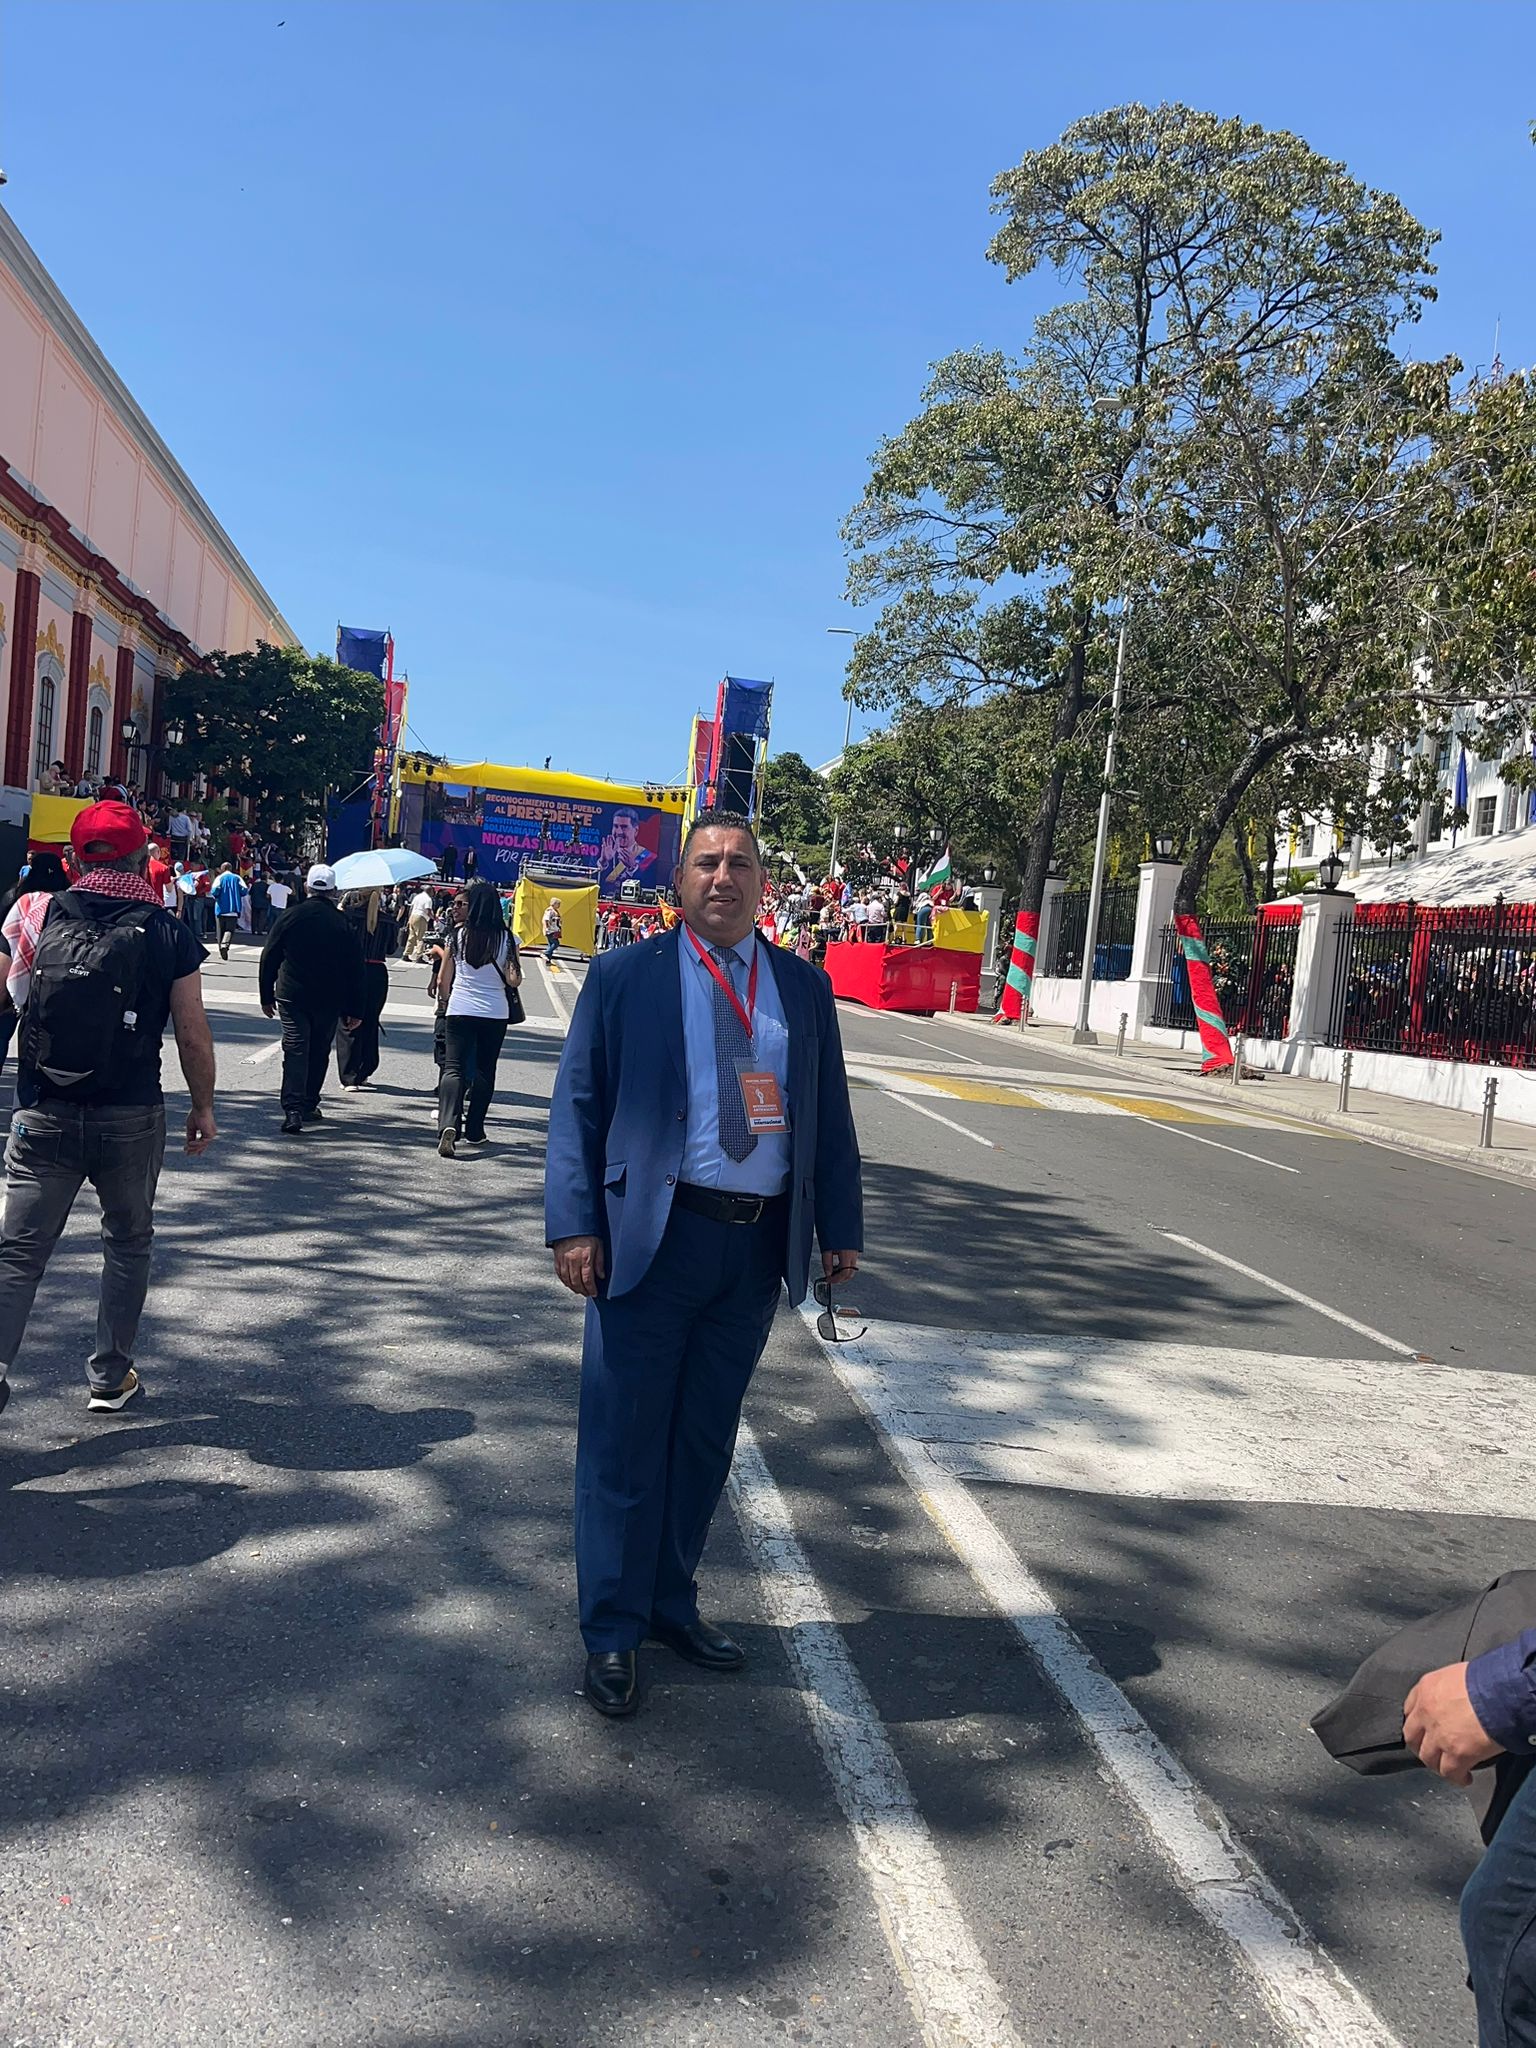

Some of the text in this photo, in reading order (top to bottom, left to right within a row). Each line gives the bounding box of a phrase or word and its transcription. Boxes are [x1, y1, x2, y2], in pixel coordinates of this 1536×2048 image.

[485, 794, 603, 814] RECONOCIMIENTO DEL PUEBLO
[494, 806, 506, 814] AL
[506, 804, 593, 826] PRESDENE
[552, 831, 600, 843] VENEUELA
[563, 826, 600, 835] REBLICA
[482, 832, 540, 850] NICOLÁS
[495, 848, 519, 863] POR
